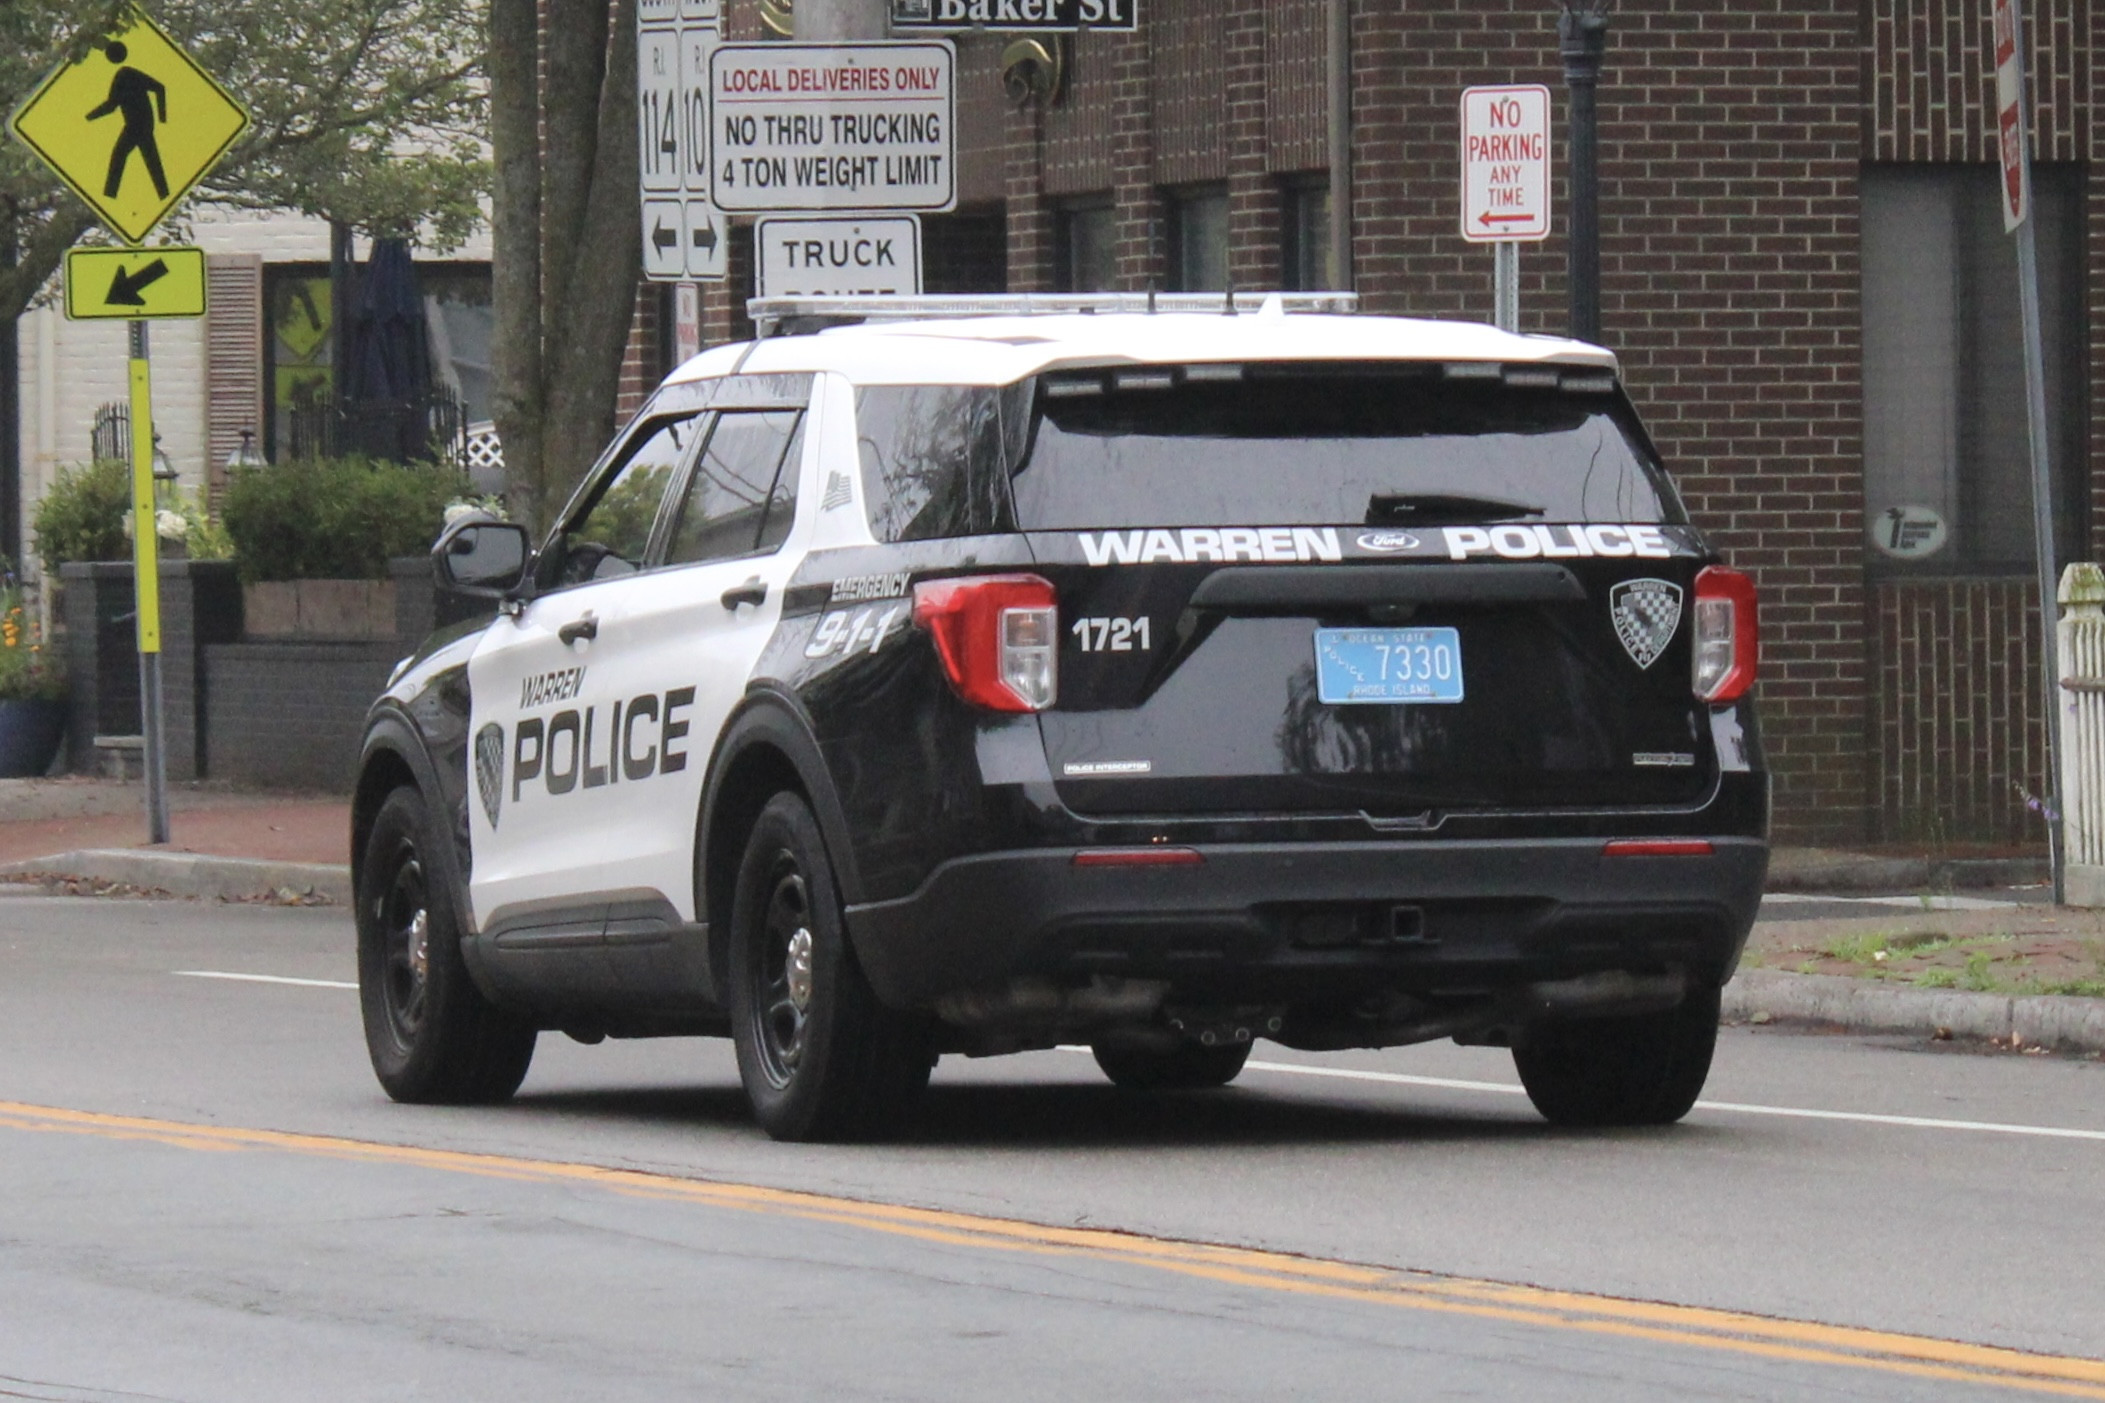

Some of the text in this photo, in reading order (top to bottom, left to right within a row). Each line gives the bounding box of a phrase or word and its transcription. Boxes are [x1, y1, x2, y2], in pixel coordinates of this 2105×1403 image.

[937, 0, 1123, 21] Baker St
[722, 67, 940, 92] LOCAL DELIVERIES ONLY
[725, 112, 940, 146] NO THRU TRUCKING
[1489, 100, 1521, 128] NO
[642, 88, 677, 175] 114
[684, 86, 706, 176] 10
[1469, 132, 1543, 162] PARKING
[722, 154, 942, 187] 4 TON WEIGHT LIMIT
[1489, 164, 1522, 184] ANY
[1487, 186, 1525, 207] TIME
[782, 239, 896, 268] TRUCK
[1078, 524, 1671, 566] WARREN POLICE
[831, 571, 911, 602] EMERGENCY
[804, 605, 899, 659] 9-1-1
[1071, 615, 1150, 651] 1721
[1348, 632, 1385, 644] OCEAN
[1392, 631, 1426, 643] STATE
[1323, 645, 1365, 682] POLICE
[1375, 643, 1451, 681] 7330
[519, 665, 588, 709] WARREN
[1352, 683, 1431, 696] RHODE ISLAND
[511, 684, 697, 803] POLICE
